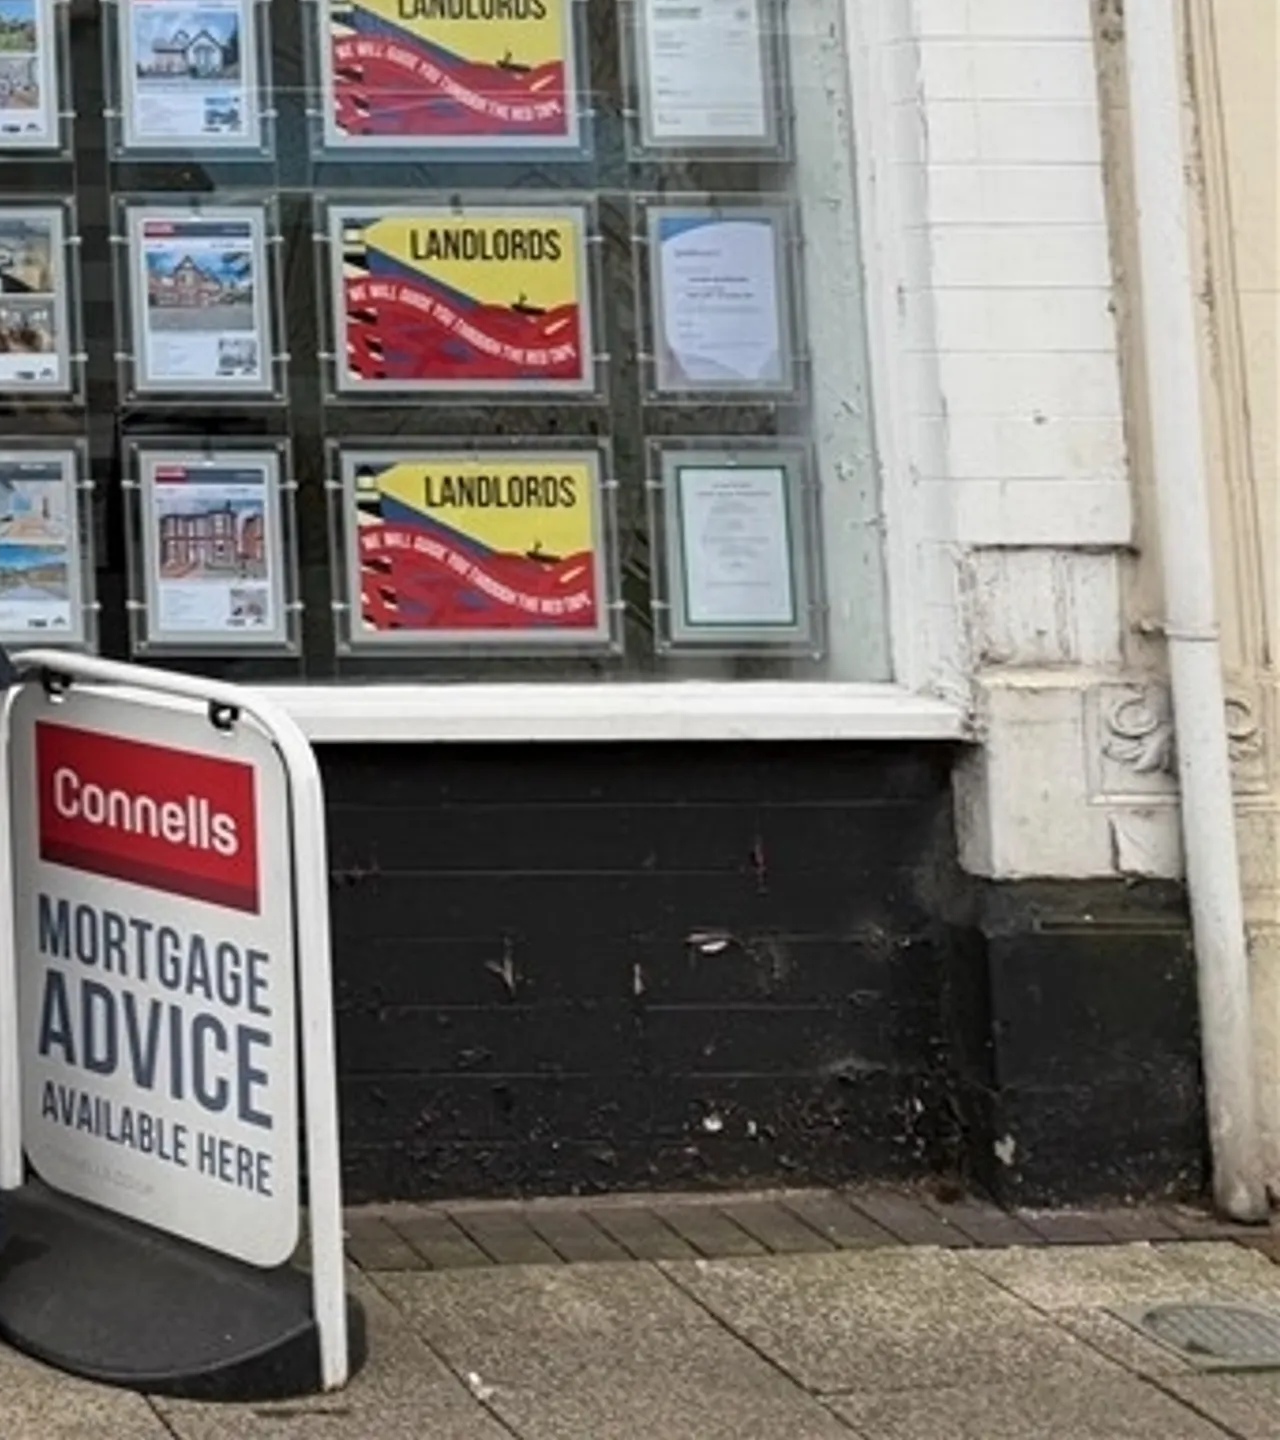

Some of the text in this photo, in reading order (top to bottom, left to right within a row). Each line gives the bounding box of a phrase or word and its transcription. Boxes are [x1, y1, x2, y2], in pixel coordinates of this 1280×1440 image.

[410, 229, 561, 260] LANDLORDS
[424, 476, 577, 508] LANDLORDS
[53, 768, 238, 856] Connells
[38, 893, 272, 1017] MORTGAGE
[38, 968, 273, 1130] ADVICE
[42, 1081, 189, 1167] AVAILABLE
[197, 1132, 273, 1197] HERE
